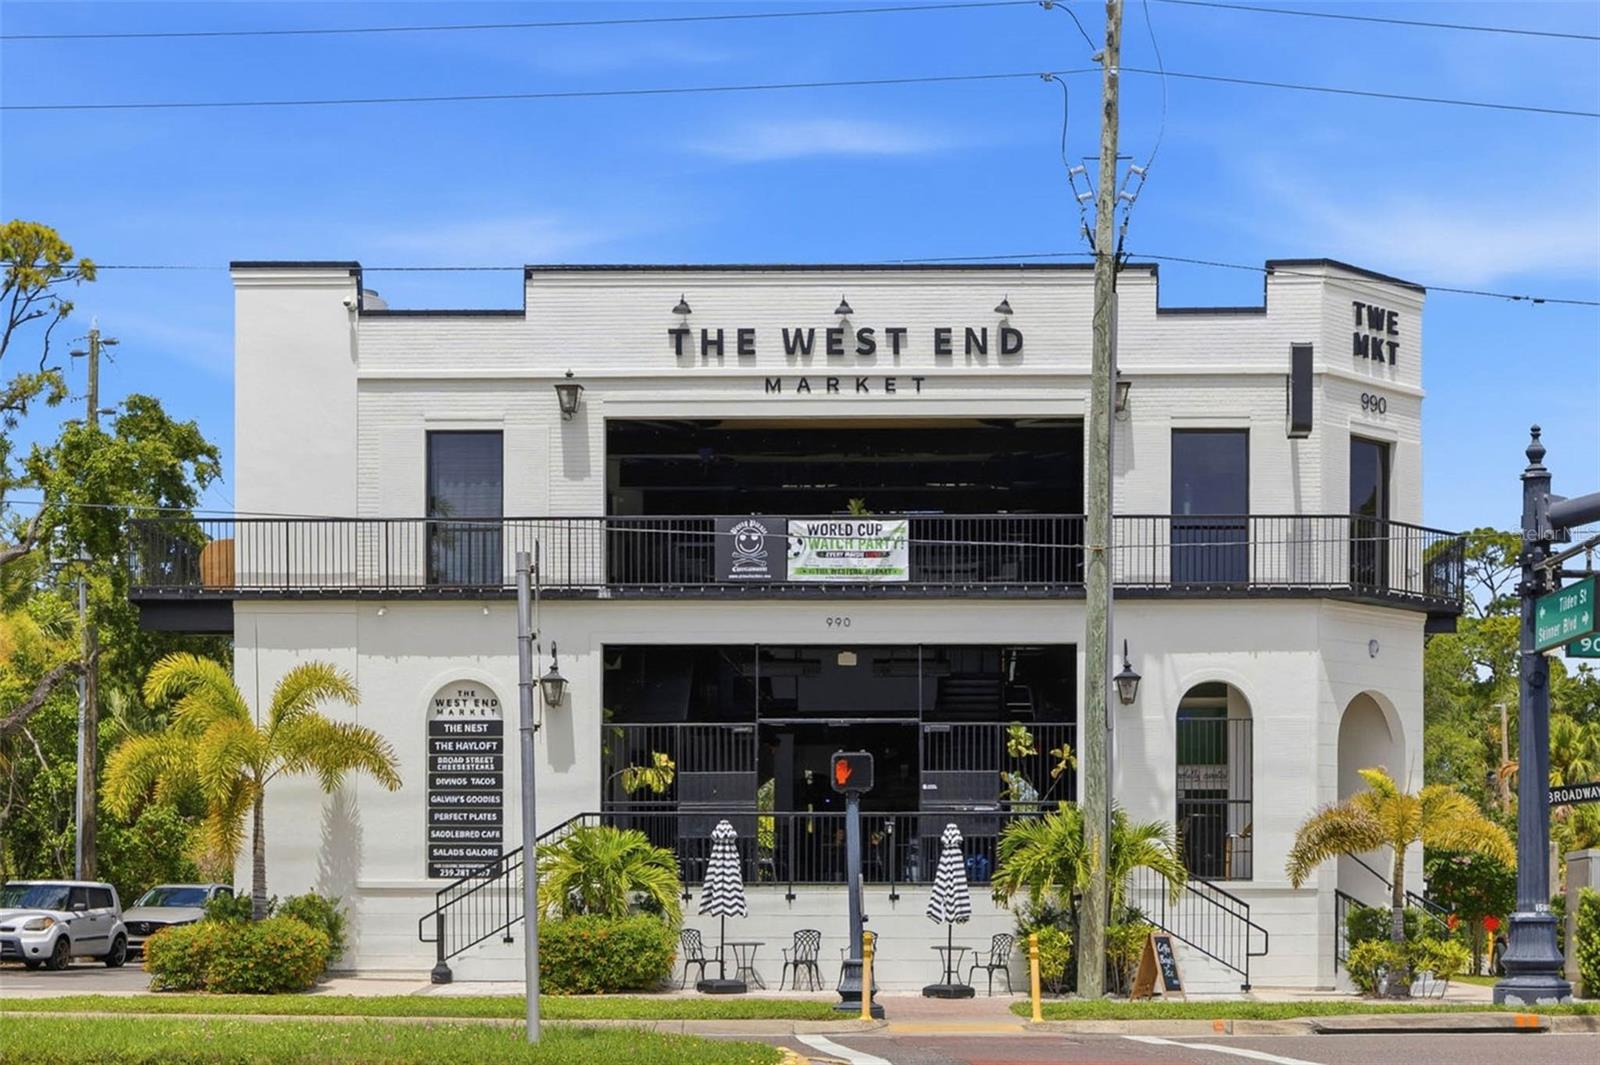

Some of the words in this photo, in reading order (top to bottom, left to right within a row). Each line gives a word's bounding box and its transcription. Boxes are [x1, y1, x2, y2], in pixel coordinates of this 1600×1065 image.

[1352, 301, 1399, 335] TWE
[668, 328, 756, 356] THE
[782, 328, 908, 356] WEST
[934, 327, 1024, 356] END
[1353, 332, 1400, 366] MKT
[765, 376, 926, 394] MARKET
[1361, 392, 1387, 414] 990
[807, 523, 854, 537] WORLD
[857, 523, 882, 536] CUP
[807, 537, 853, 550] WATCH
[1559, 594, 1578, 612] Tilden
[1579, 589, 1587, 604] St
[826, 617, 851, 627] 990
[1538, 624, 1560, 642] Skinner
[1563, 616, 1577, 634] Blvd
[435, 699, 469, 707] WEST
[474, 699, 498, 707] END
[444, 724, 463, 733] THE
[464, 724, 488, 733] NEST
[435, 742, 454, 751] THE
[455, 741, 498, 750] HAYLOFT
[437, 756, 464, 764] BROAD
[465, 756, 494, 764] STREET
[470, 777, 496, 785] TACOS
[466, 795, 501, 803] GOODIES
[1548, 786, 1600, 804] BROADWAY
[434, 812, 468, 821] PERFECT
[469, 812, 497, 820] PLATES
[431, 830, 480, 838] SADDLEBRED
[433, 848, 465, 857] SALADS
[466, 848, 499, 857] GALORE
